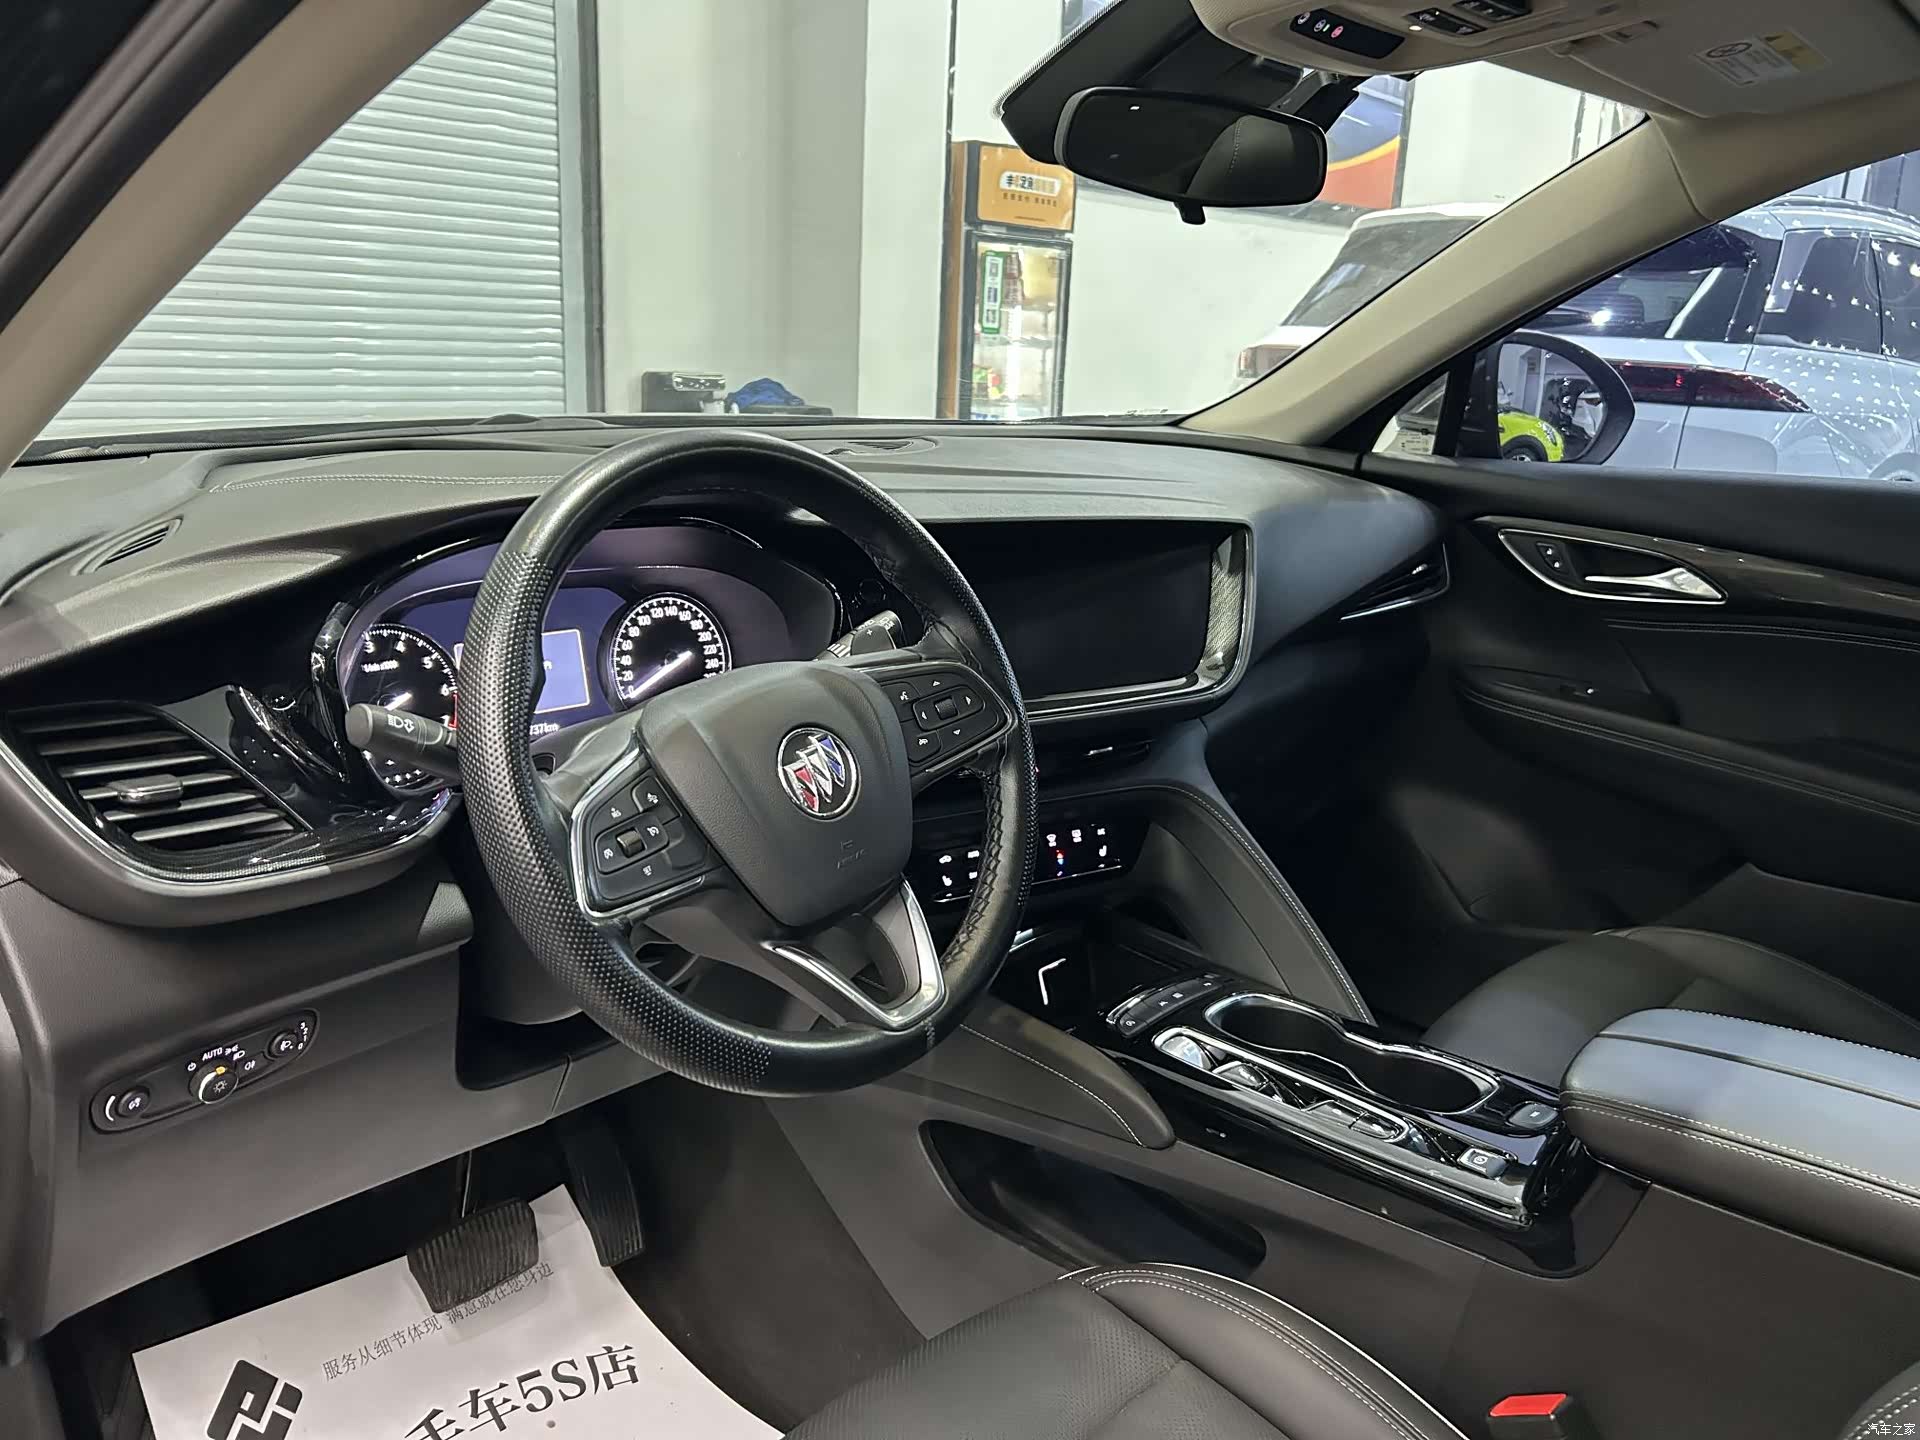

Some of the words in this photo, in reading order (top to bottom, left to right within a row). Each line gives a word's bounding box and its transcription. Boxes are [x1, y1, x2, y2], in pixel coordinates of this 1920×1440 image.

[650, 607, 663, 618] 120
[664, 606, 678, 617] 140
[679, 610, 691, 621] 160
[637, 615, 651, 626] 100
[690, 619, 704, 630] 180
[628, 626, 640, 637] 80
[697, 631, 712, 642] 200
[364, 640, 375, 653] 3
[395, 640, 406, 653] 4
[622, 640, 633, 651] 60
[703, 643, 717, 655] 220
[421, 656, 433, 669] 5
[620, 655, 632, 666] 40
[705, 658, 719, 670] 240
[622, 670, 633, 681] 20
[441, 683, 450, 696] 6
[202, 1047, 223, 1062] AUTO
[322, 1314, 443, 1382] 服务从细节体现
